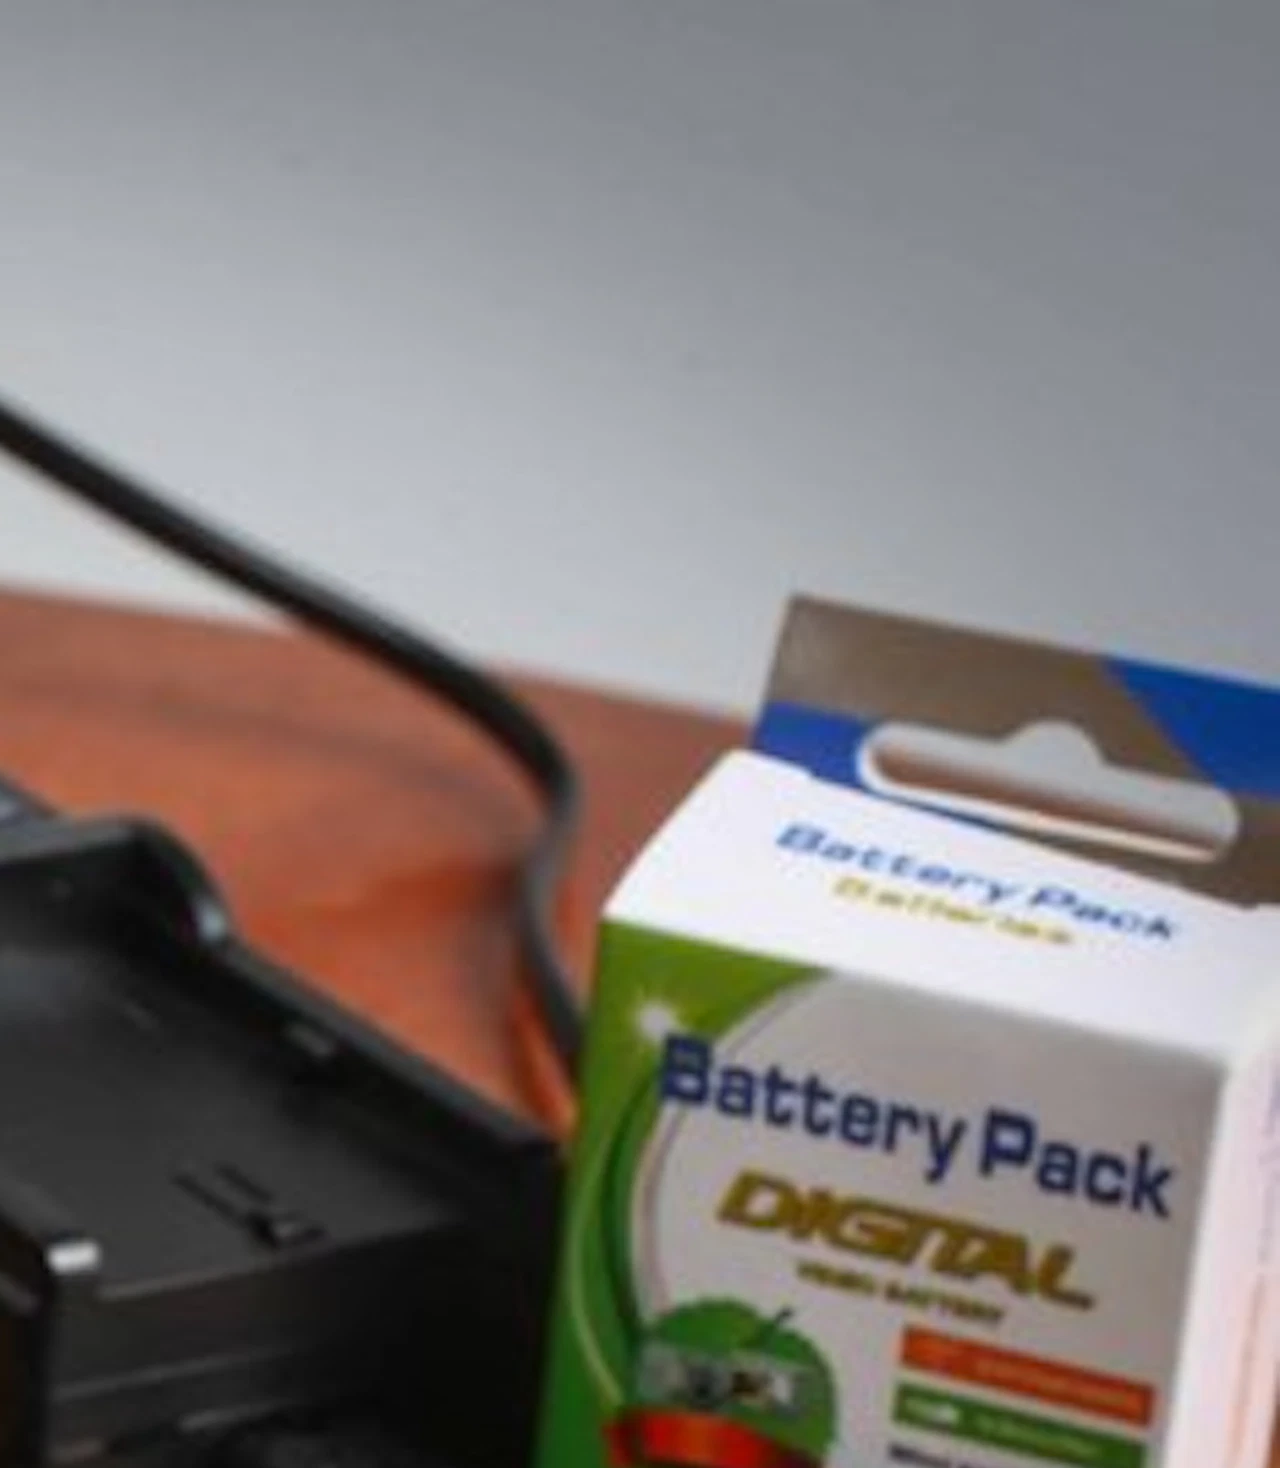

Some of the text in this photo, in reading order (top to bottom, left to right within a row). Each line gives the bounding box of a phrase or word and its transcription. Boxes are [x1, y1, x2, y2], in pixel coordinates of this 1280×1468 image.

[776, 825, 1177, 940] Battery Pack
[661, 1034, 1178, 1218] Battery Pack
[717, 1170, 1095, 1311] DIGITAL
